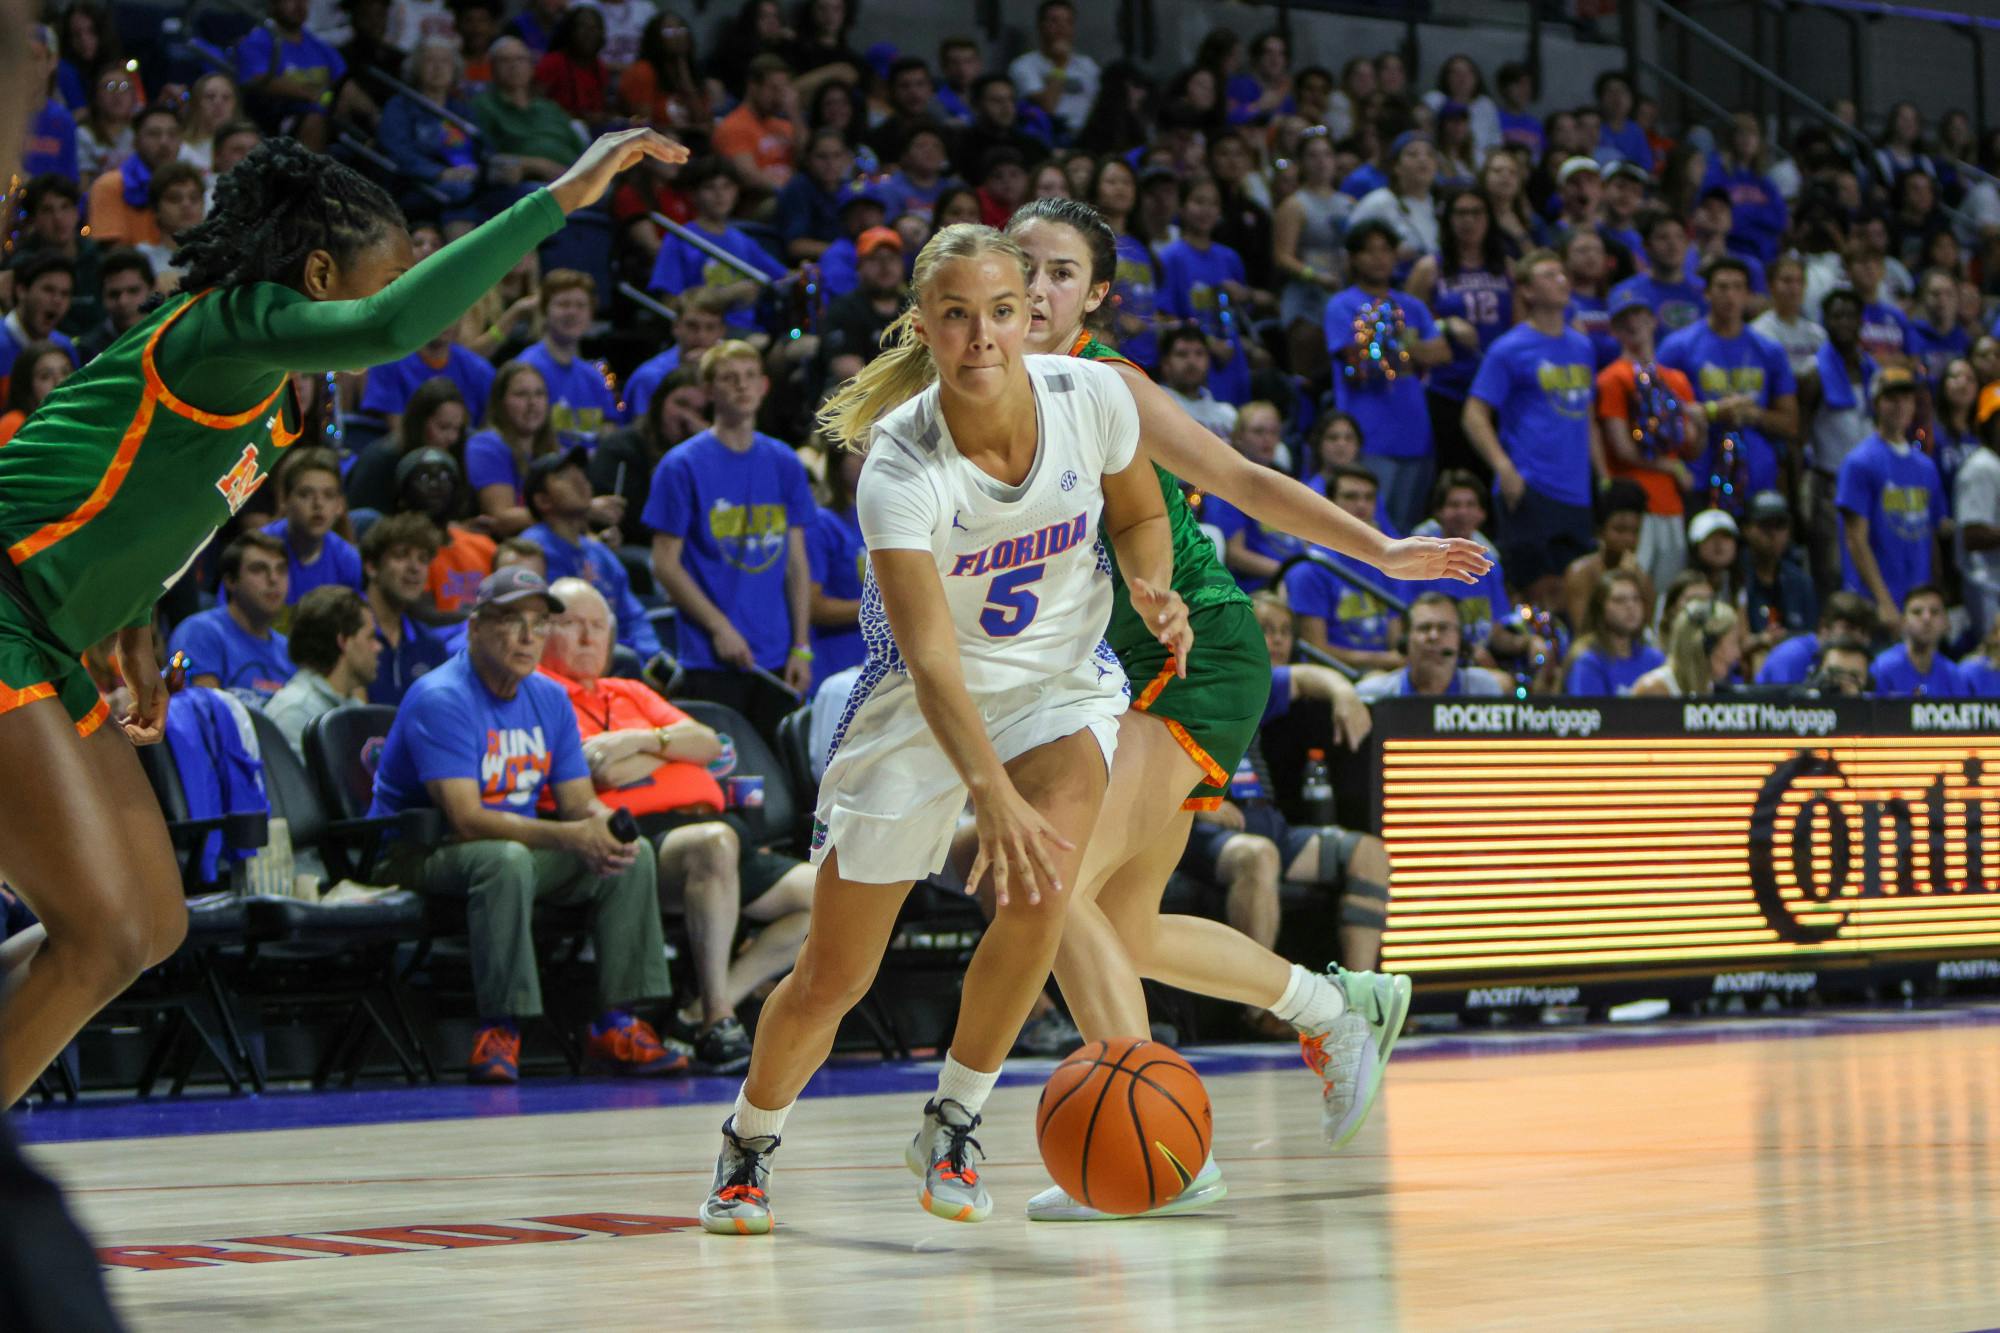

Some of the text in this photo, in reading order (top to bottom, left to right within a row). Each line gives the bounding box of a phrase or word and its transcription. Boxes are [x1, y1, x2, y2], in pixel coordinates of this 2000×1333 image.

[1062, 471, 1077, 491] SEC
[948, 511, 1087, 577] FLORIDA
[979, 563, 1046, 637] 5
[1434, 703, 1601, 737] ROCKET Mortgage
[1684, 704, 1837, 736] ROCKET Mortgage
[487, 726, 546, 760] RUN
